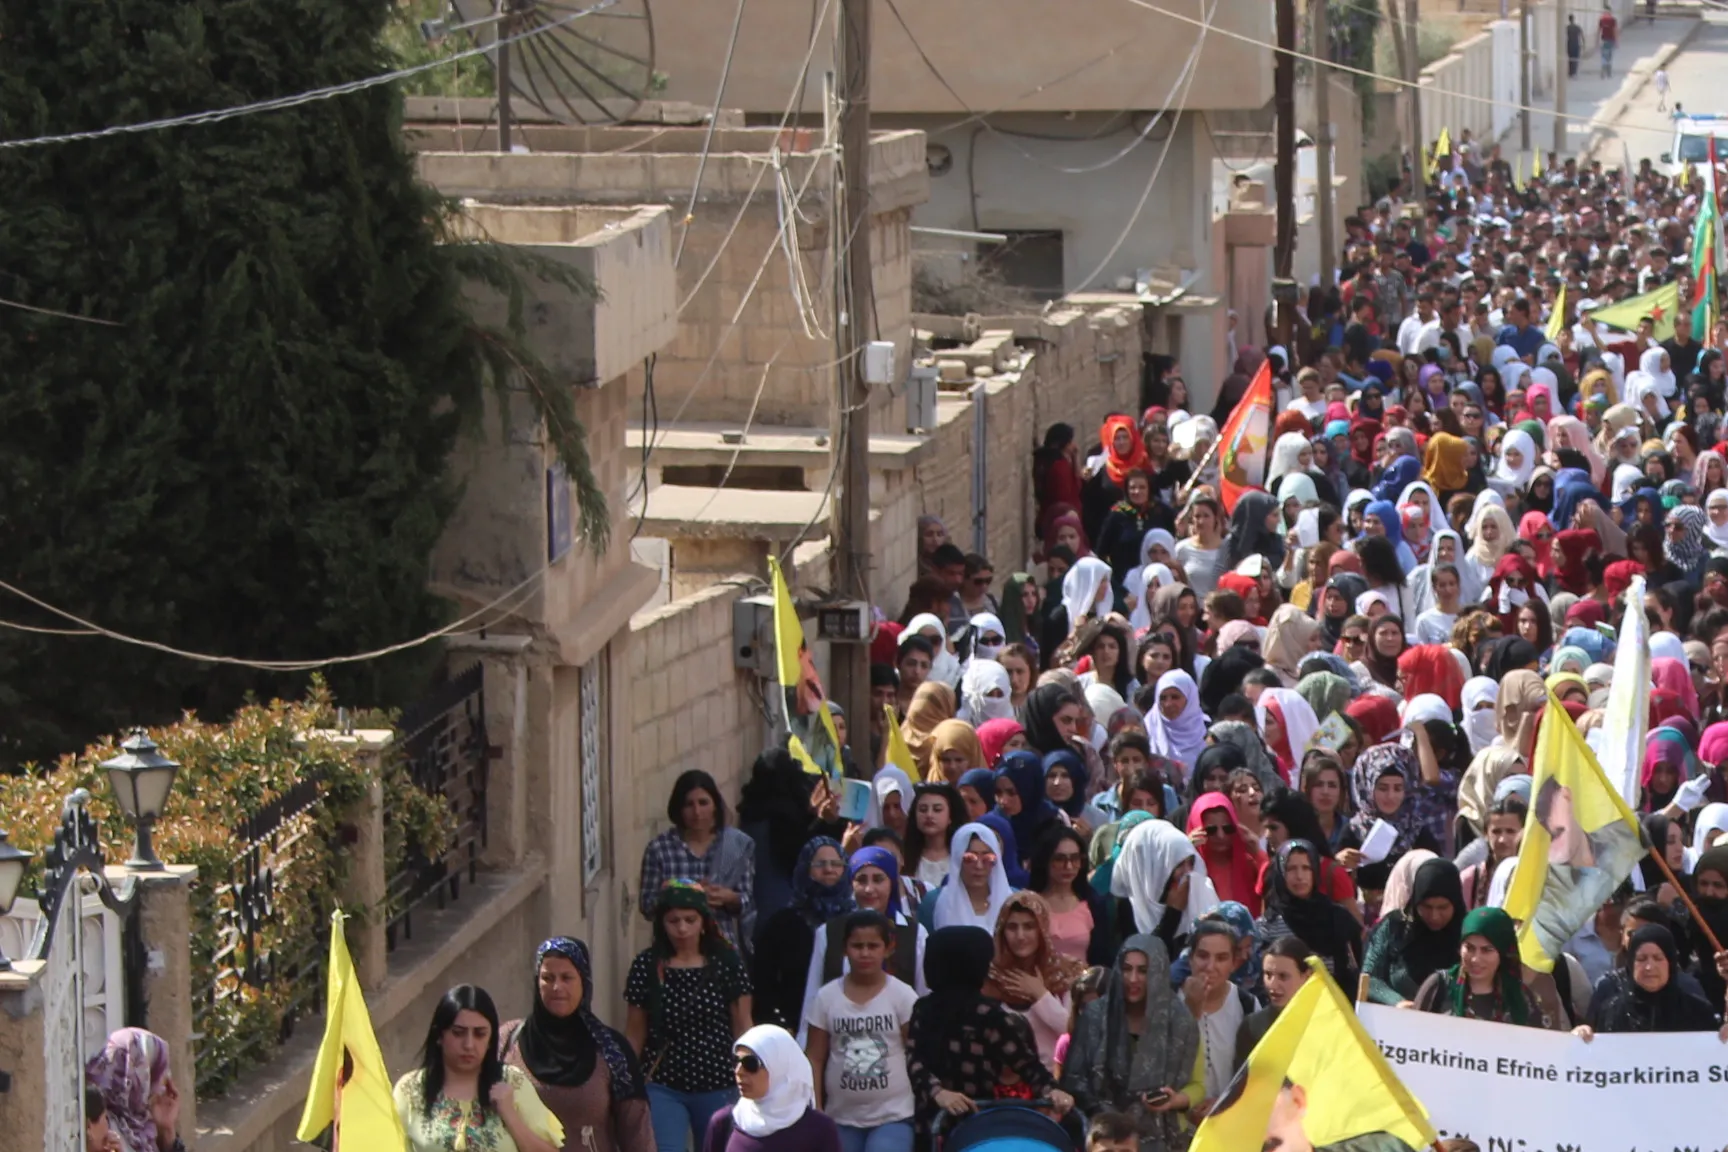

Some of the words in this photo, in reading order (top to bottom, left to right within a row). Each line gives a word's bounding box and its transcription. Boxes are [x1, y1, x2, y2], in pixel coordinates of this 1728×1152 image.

[833, 1013, 894, 1034] UNICORN
[1372, 1039, 1488, 1073] izgarkirina
[1496, 1057, 1558, 1082] Efrînê
[1566, 1065, 1700, 1088] rizgarkirina
[840, 1073, 888, 1092] SQUAD
